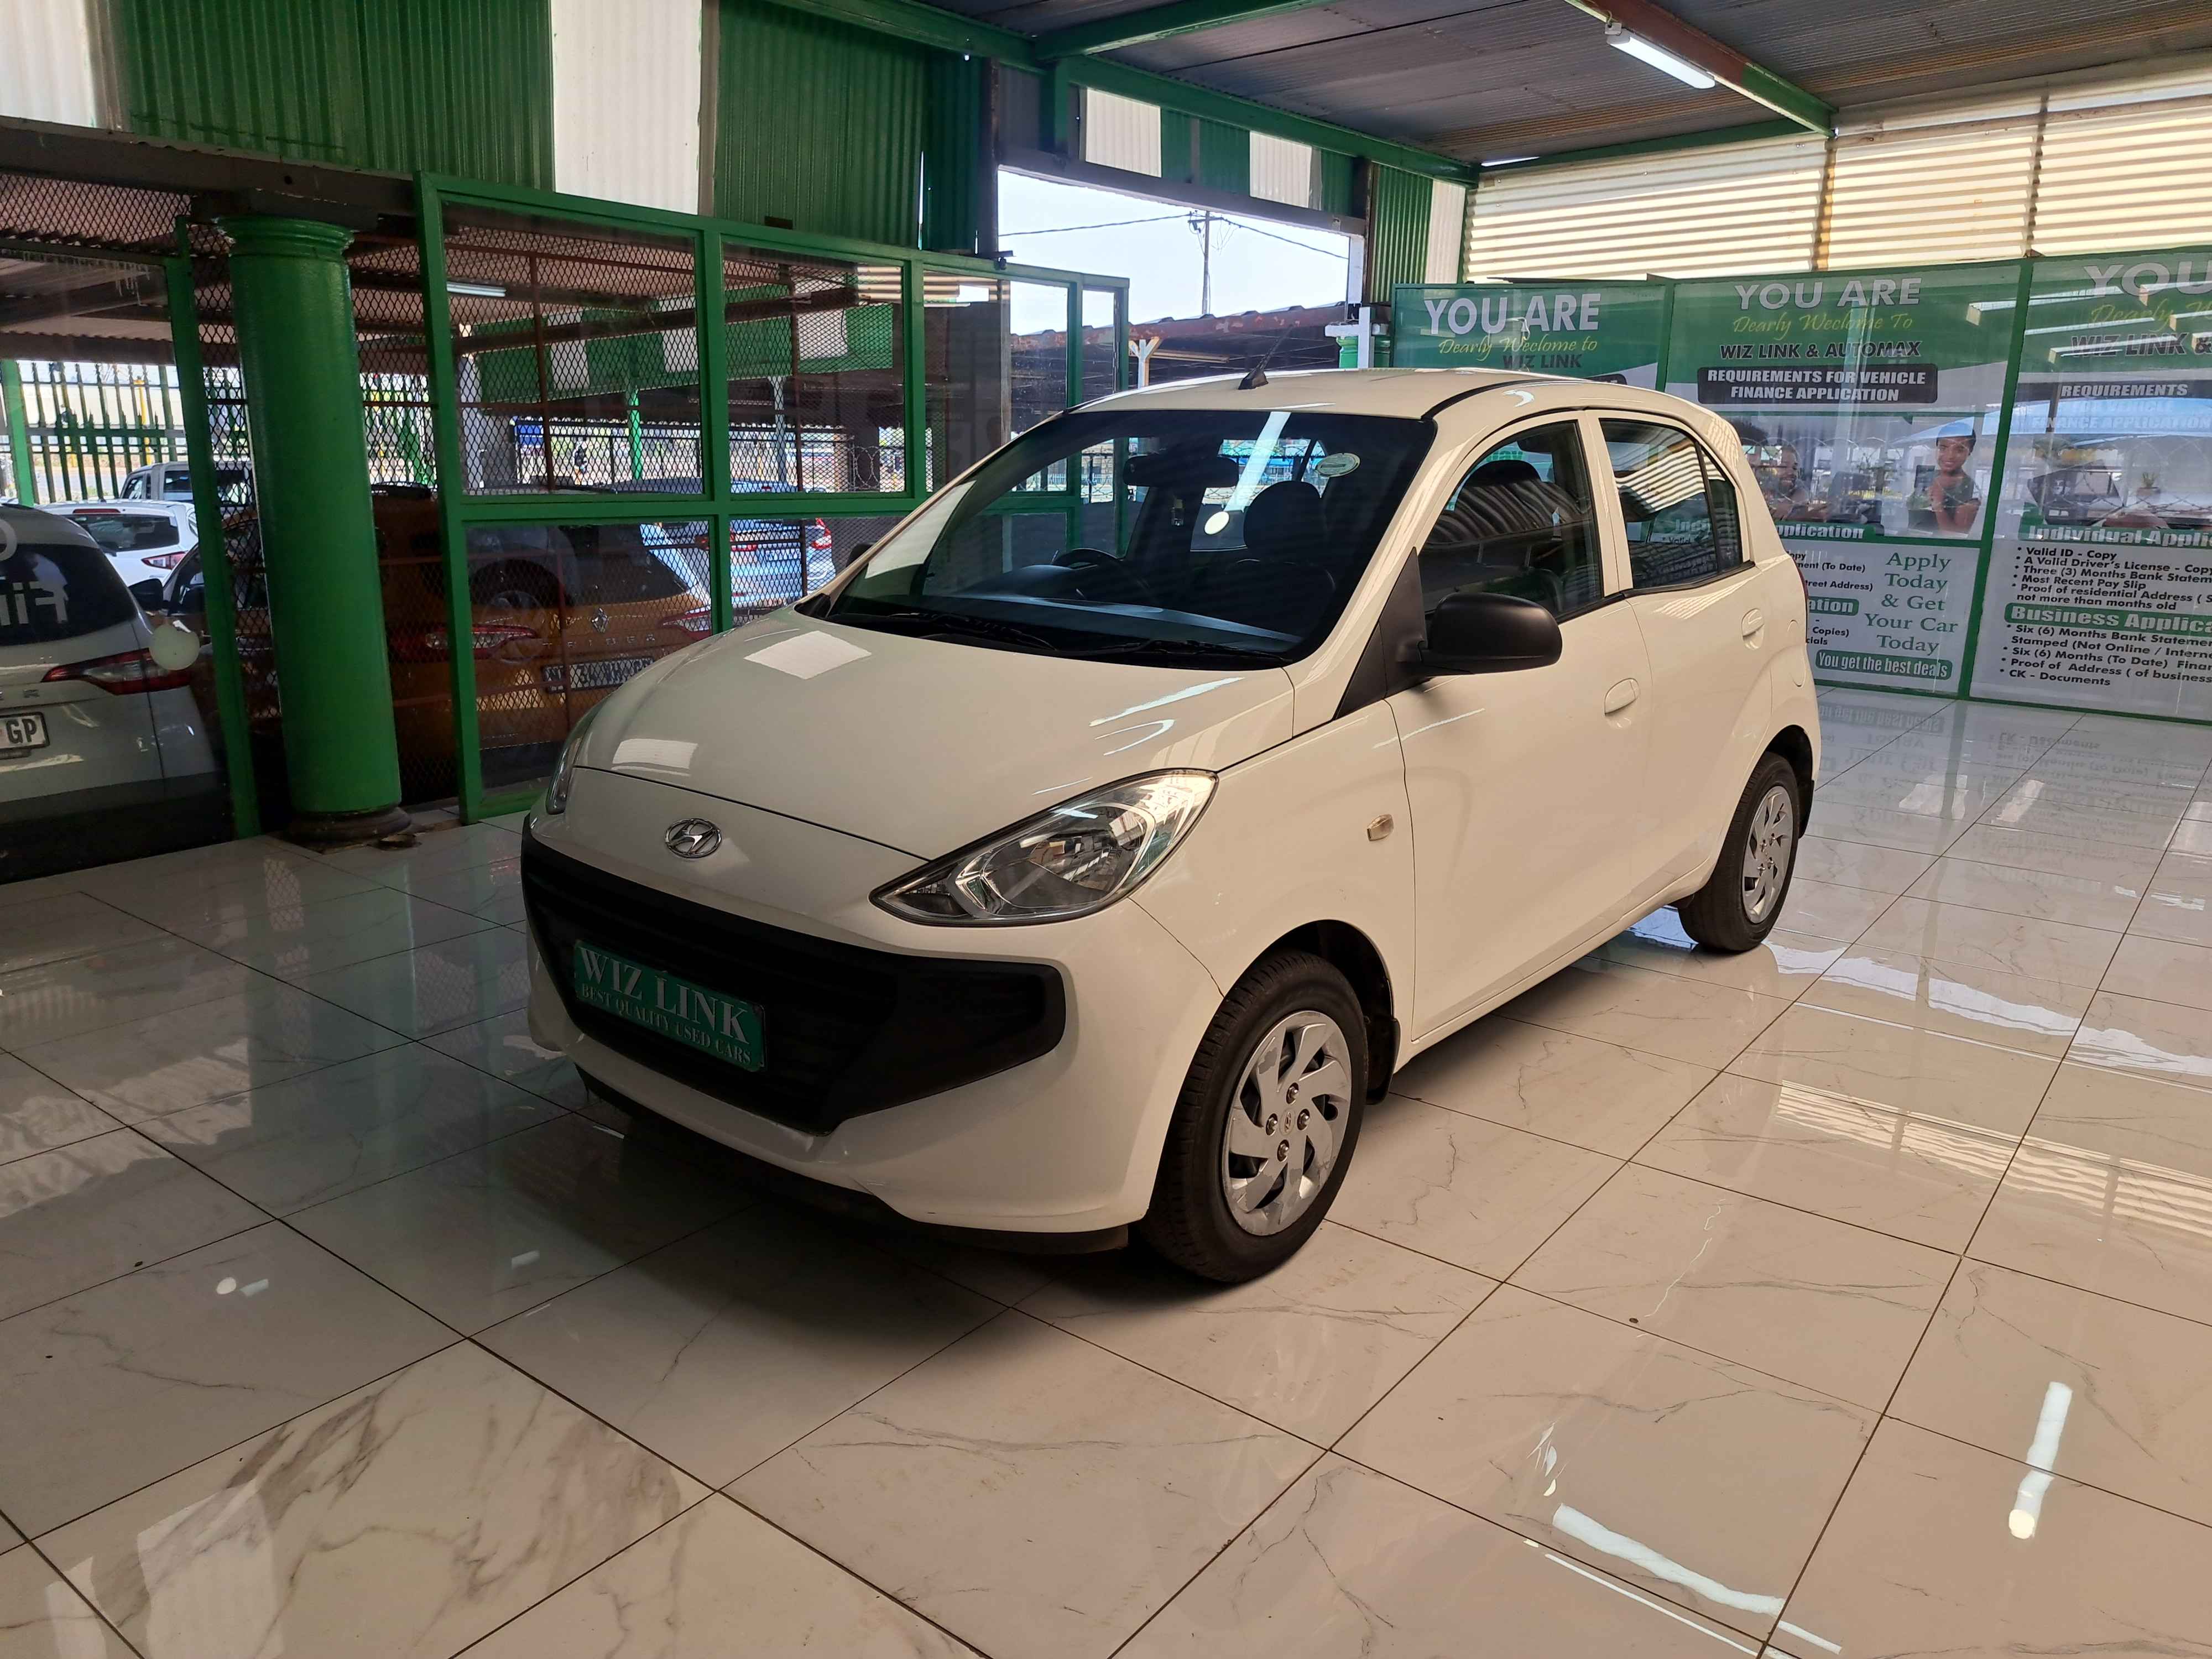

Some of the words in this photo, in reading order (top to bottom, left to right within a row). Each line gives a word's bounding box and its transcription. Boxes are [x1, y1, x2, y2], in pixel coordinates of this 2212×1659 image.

[1734, 281, 1823, 310] YOU
[1837, 277, 1922, 307] ARE
[1424, 296, 1508, 335] YOU
[1525, 293, 1602, 332] ARE
[1733, 311, 1792, 341] Dearly
[1890, 313, 1913, 329] To
[1438, 333, 1493, 361] Dearly
[1500, 333, 1576, 353] Weclome
[1582, 335, 1598, 352] to
[1720, 344, 1754, 359] WIZ
[1758, 343, 1802, 359] LINK
[1806, 343, 1820, 359] &
[1824, 341, 1923, 358] AUTOMAX
[2071, 334, 2121, 357] WIZ
[2125, 332, 2189, 356] LINK
[1503, 354, 1536, 369] WIZ
[1540, 353, 1583, 369] LINK
[1707, 369, 1823, 383] REQUIREMENTS
[1825, 371, 1856, 384] FOR
[1860, 371, 1926, 385] VEHICLE
[1730, 386, 1793, 399] FINANCE
[1796, 387, 1900, 401] APPLICATION
[2061, 383, 2189, 398] REQUIREMENTS
[2028, 525, 2142, 544] Individual
[2147, 530, 2212, 547] Appli
[1885, 552, 1952, 573] Apply
[2026, 546, 2057, 556] Valid
[2060, 549, 2074, 557] ID
[2086, 550, 2117, 561] Copy
[1822, 562, 1836, 571] (To
[1839, 563, 1866, 573] Date)
[2023, 565, 2057, 575] Three
[2060, 567, 2077, 578] (3)
[2080, 568, 2126, 579] Months
[2130, 571, 2163, 581] Bank
[2024, 556, 2033, 565] A
[2037, 557, 2068, 566] Valid
[2124, 561, 2171, 572] License
[1830, 581, 1874, 592] Address)
[1884, 572, 1948, 593] Today
[2021, 575, 2051, 583] Most
[2053, 576, 2094, 586] Recent
[2097, 579, 2120, 589] Pay
[2123, 580, 2147, 591] Slip
[1881, 593, 1900, 608] &
[1907, 596, 1946, 611] Get
[2020, 584, 2053, 593] Proof
[2056, 585, 2068, 594] of
[2070, 587, 2137, 598] residential
[2140, 591, 2193, 602] Address
[2074, 597, 2103, 607] than
[2106, 599, 2152, 609] months
[2156, 602, 2177, 611] old
[1864, 613, 1913, 630] Your
[1920, 617, 1959, 633] Car
[2011, 606, 2120, 627] Business
[1812, 626, 1850, 637] Copies)
[2016, 625, 2034, 634] Six
[2038, 627, 2055, 637] (6)
[2059, 628, 2107, 639] Months
[2111, 632, 2147, 642] Bank
[1876, 634, 1940, 656] Today
[2011, 635, 2068, 648] Stamped
[2072, 640, 2101, 651] (Not
[2105, 643, 2151, 654] Online
[1819, 651, 1839, 667] You
[1841, 656, 1860, 670] get
[1862, 656, 1882, 672] the
[1884, 657, 1911, 675] best
[1913, 660, 1948, 678] deals
[2012, 647, 2031, 656] Six
[2034, 649, 2051, 660] (6)
[2055, 650, 2104, 662] Months
[2107, 655, 2127, 665] (To
[2131, 656, 2168, 669] Date)
[2008, 669, 2027, 679] CK
[2039, 671, 2111, 686] Documents
[2011, 658, 2045, 669] Proof
[2048, 661, 2062, 670] of
[2068, 663, 2122, 675] Address
[2135, 669, 2150, 678] of
[6, 718, 37, 744] GP
[578, 946, 643, 1000] WIZ
[654, 975, 750, 1045] LINK
[581, 982, 612, 1006] BEST
[615, 999, 671, 1032] QUALITY
[676, 1022, 711, 1048] USED
[715, 1039, 753, 1066] CARS
